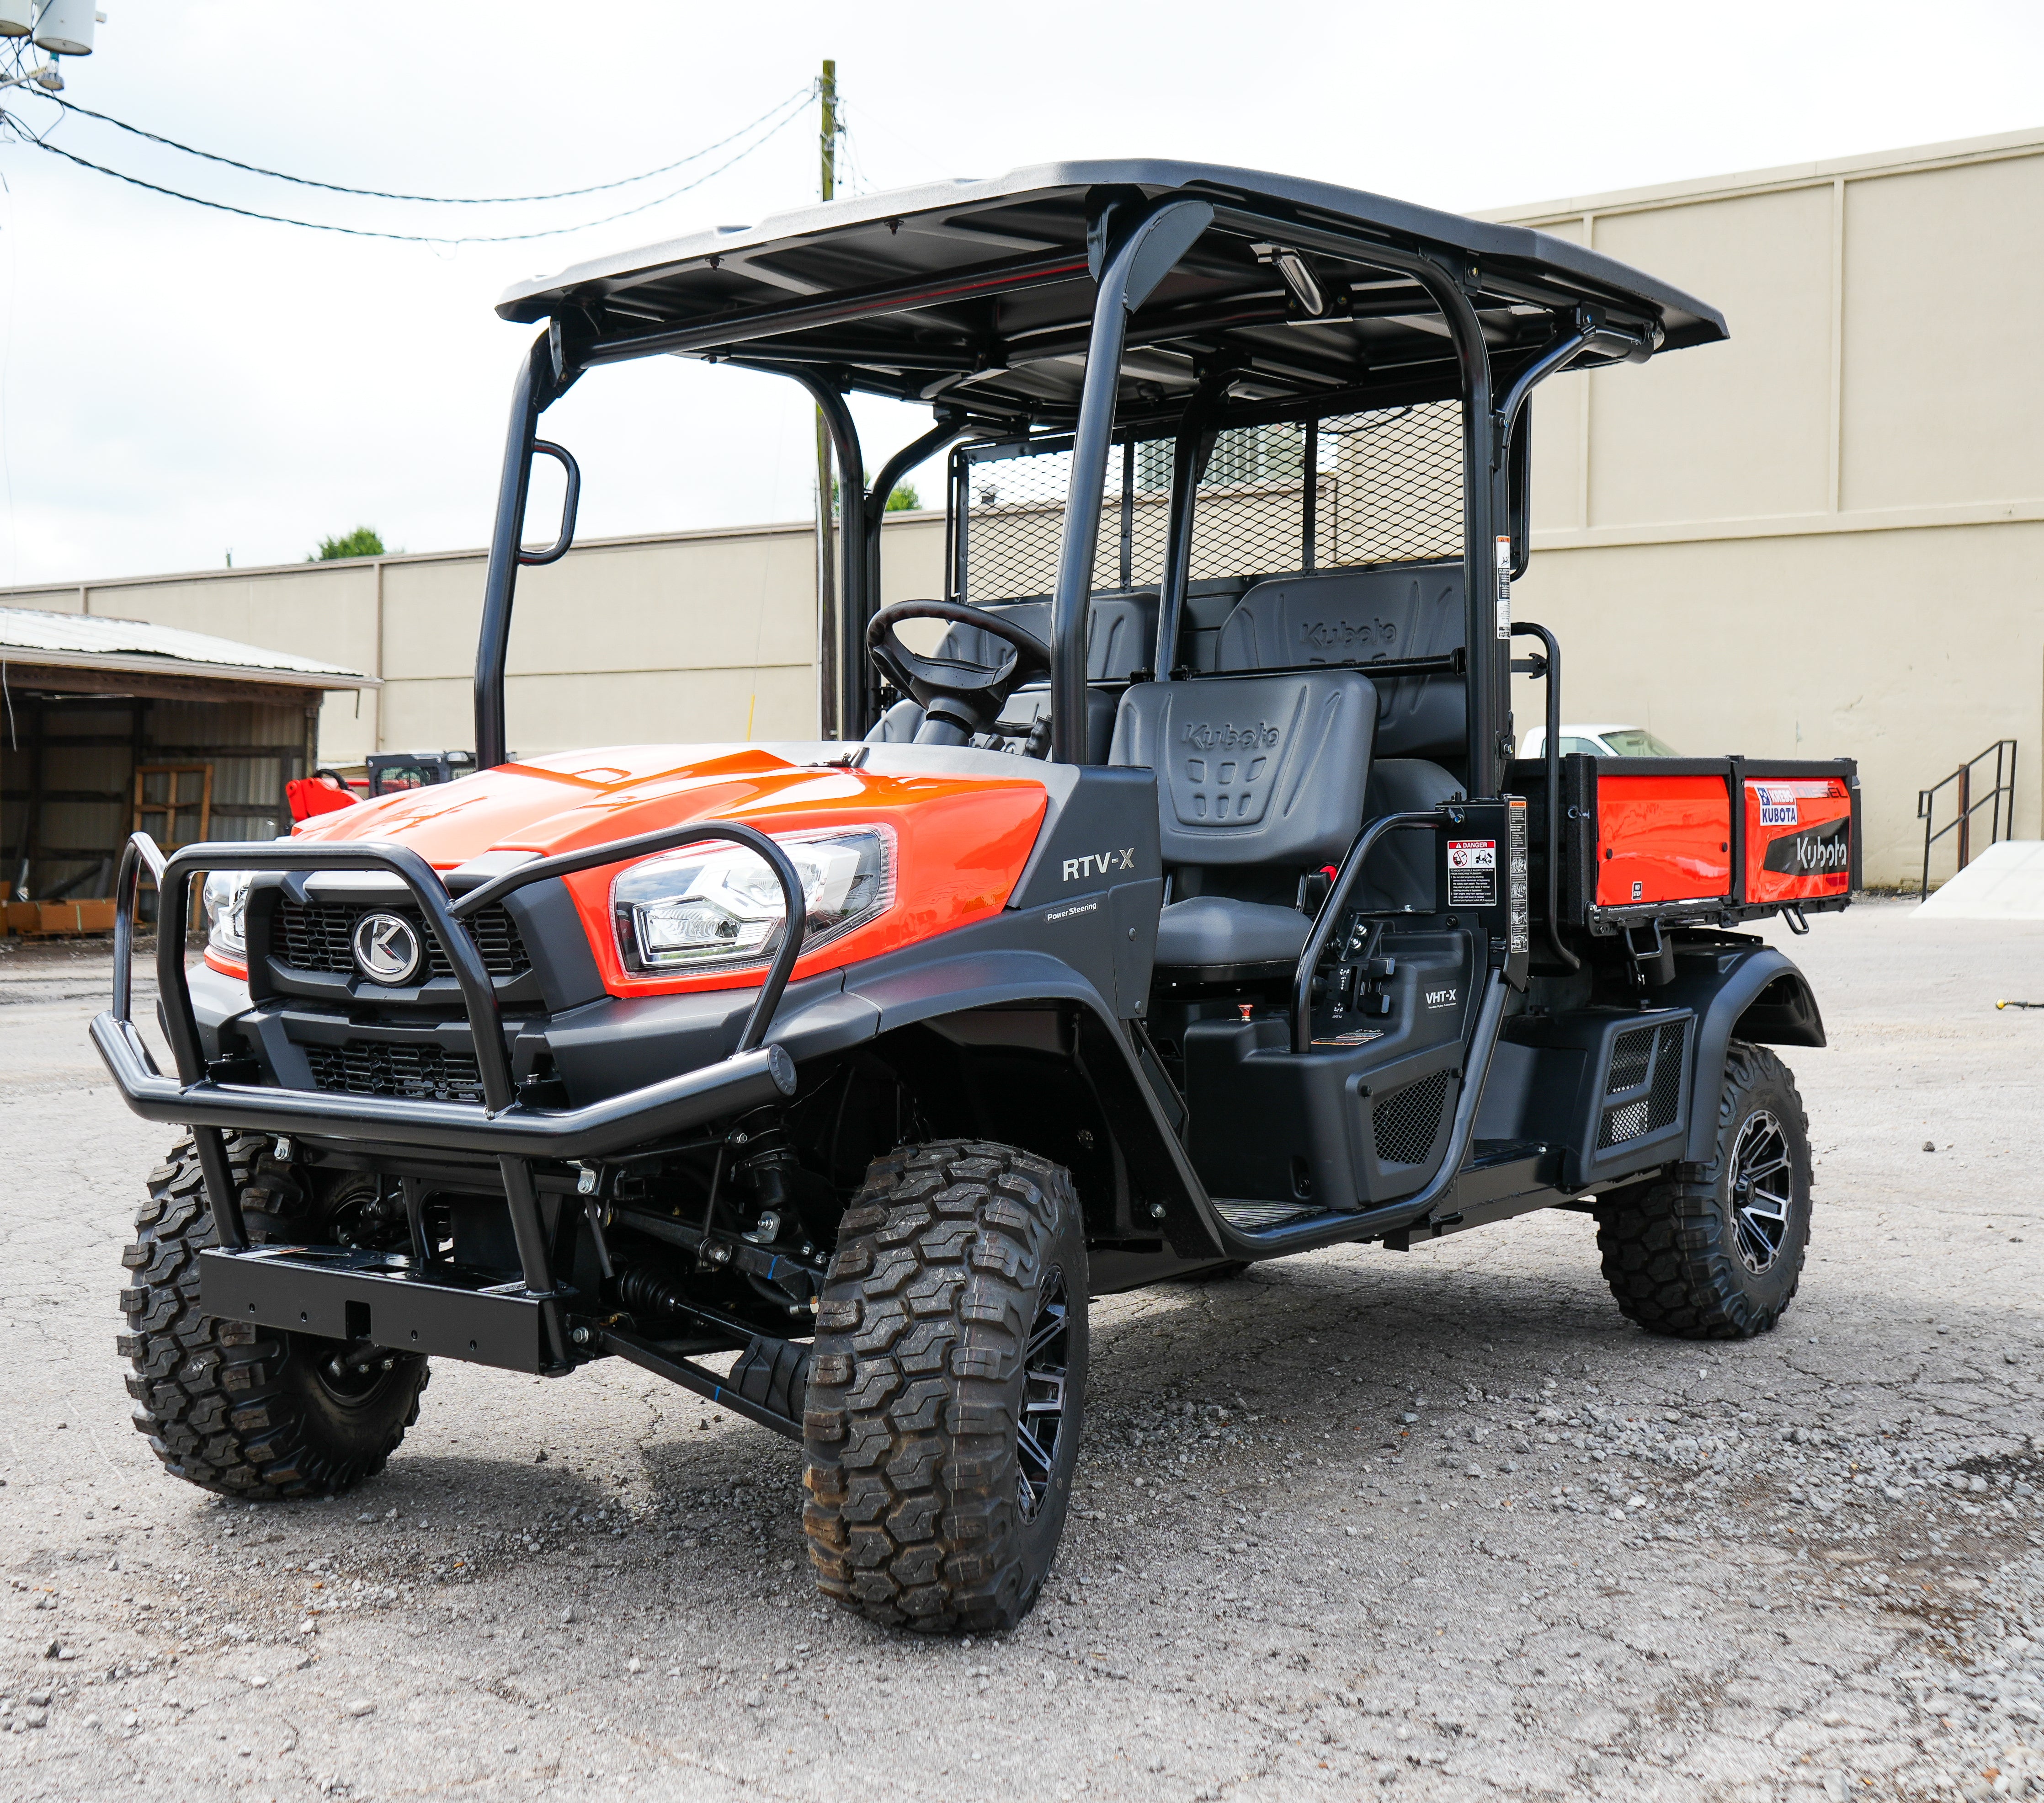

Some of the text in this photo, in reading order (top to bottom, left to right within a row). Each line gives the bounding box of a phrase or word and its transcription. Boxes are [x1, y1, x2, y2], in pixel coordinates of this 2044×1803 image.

[1300, 618, 1397, 649] Kubota
[1182, 722, 1279, 751] Kubota
[1769, 789, 1794, 803] KREBS
[1796, 787, 1848, 798] DIESEL
[1762, 808, 1796, 823] KUBOTA
[1797, 835, 1847, 869] Kubota
[1063, 848, 1134, 881] RTV-X
[1426, 989, 1456, 1004] VHT-X
